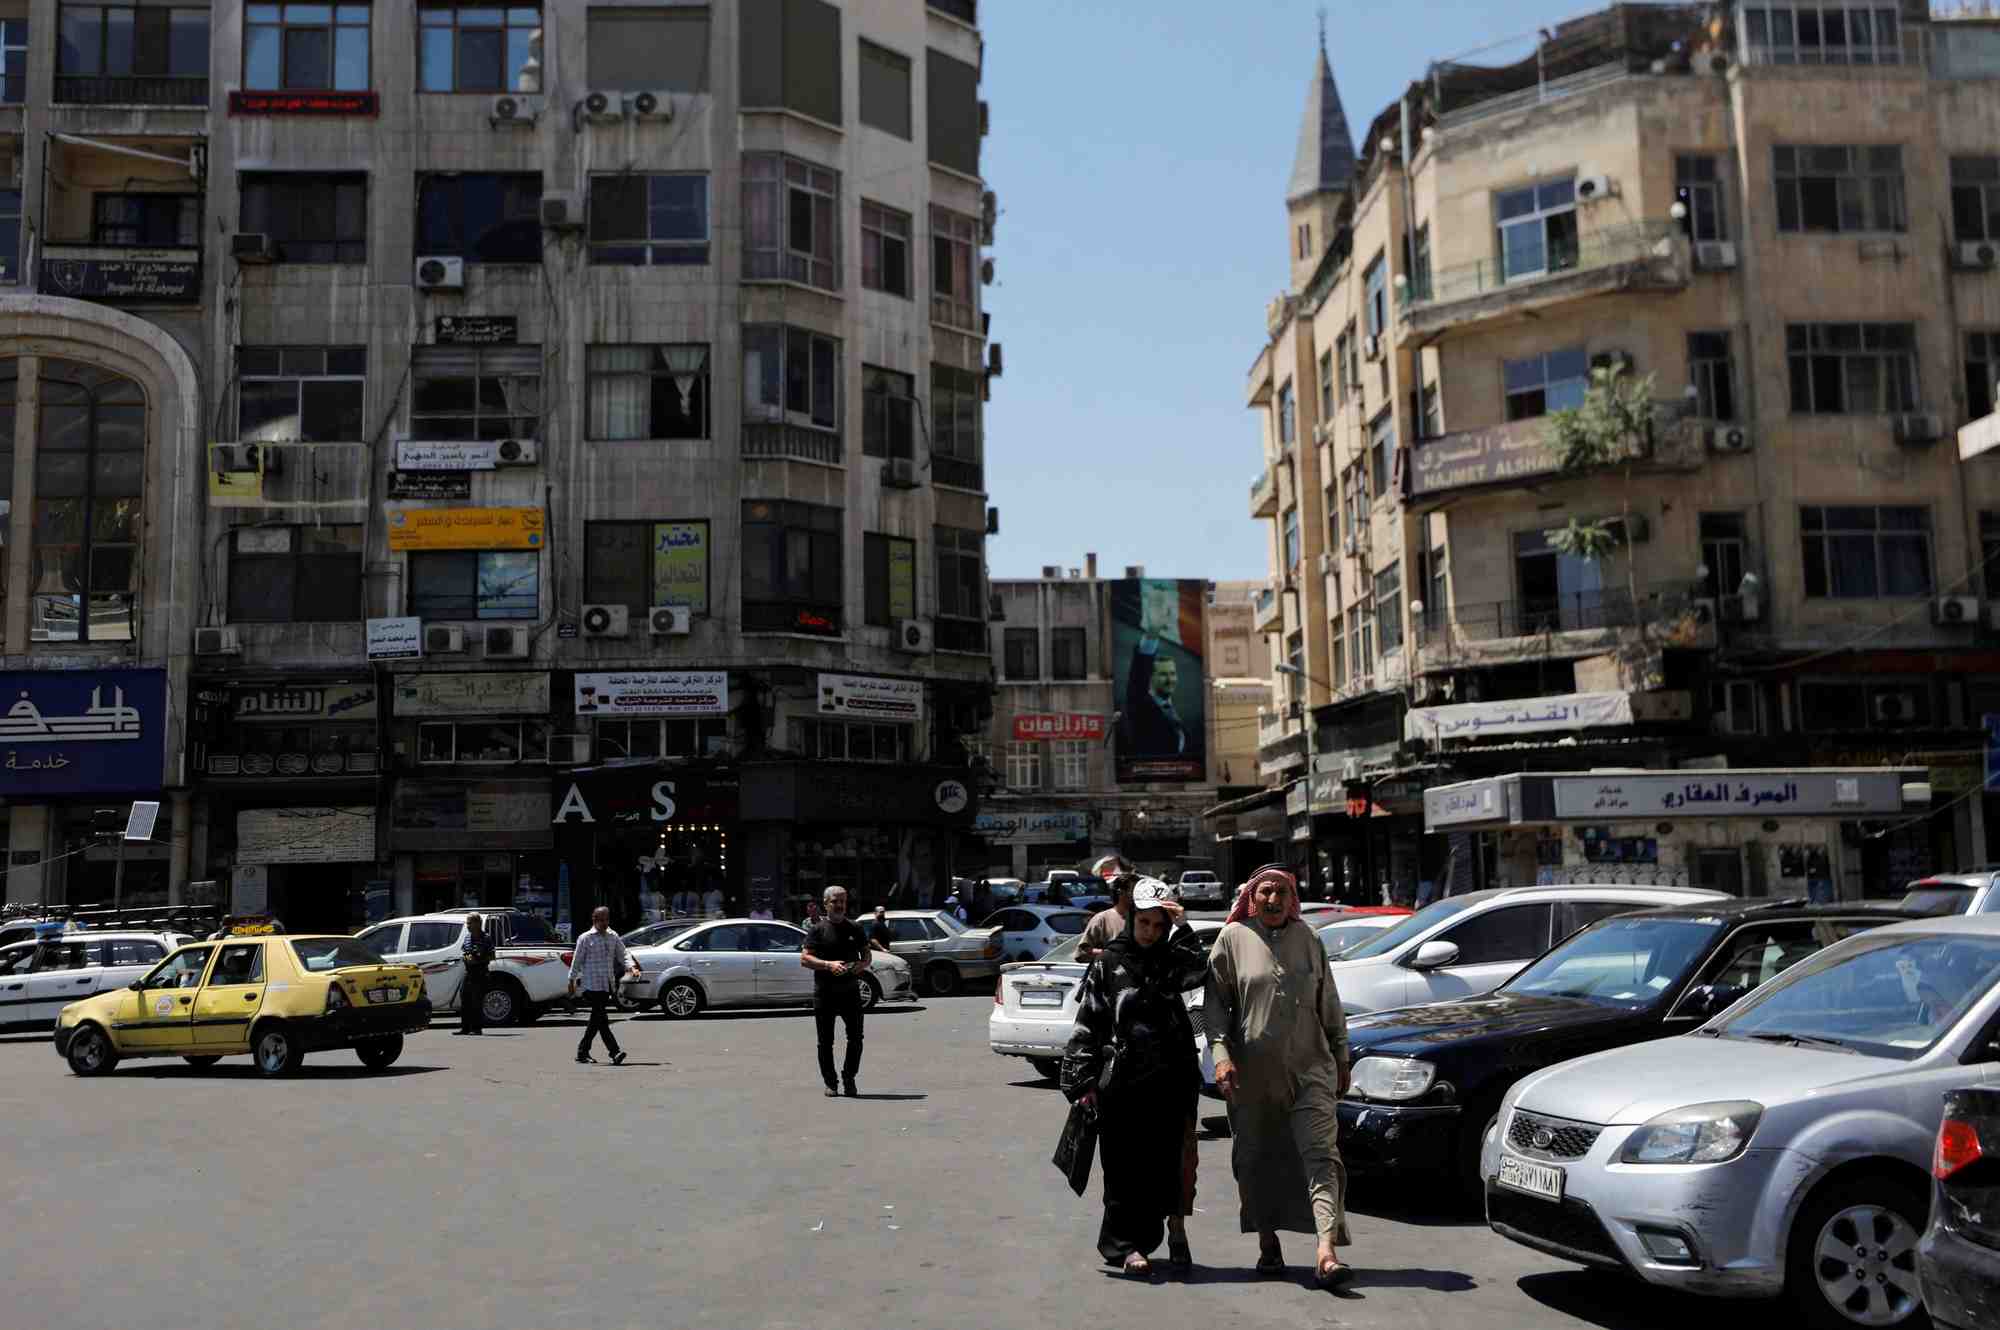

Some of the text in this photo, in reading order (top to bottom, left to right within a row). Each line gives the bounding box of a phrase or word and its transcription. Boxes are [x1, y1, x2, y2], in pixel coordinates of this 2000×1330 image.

[236, 689, 321, 714] الشام
[1445, 704, 1580, 732] القدموس
[5, 751, 73, 769] خدمة
[553, 781, 597, 822] A
[650, 781, 676, 821] S
[1662, 783, 1797, 808] المصرف العقاري
